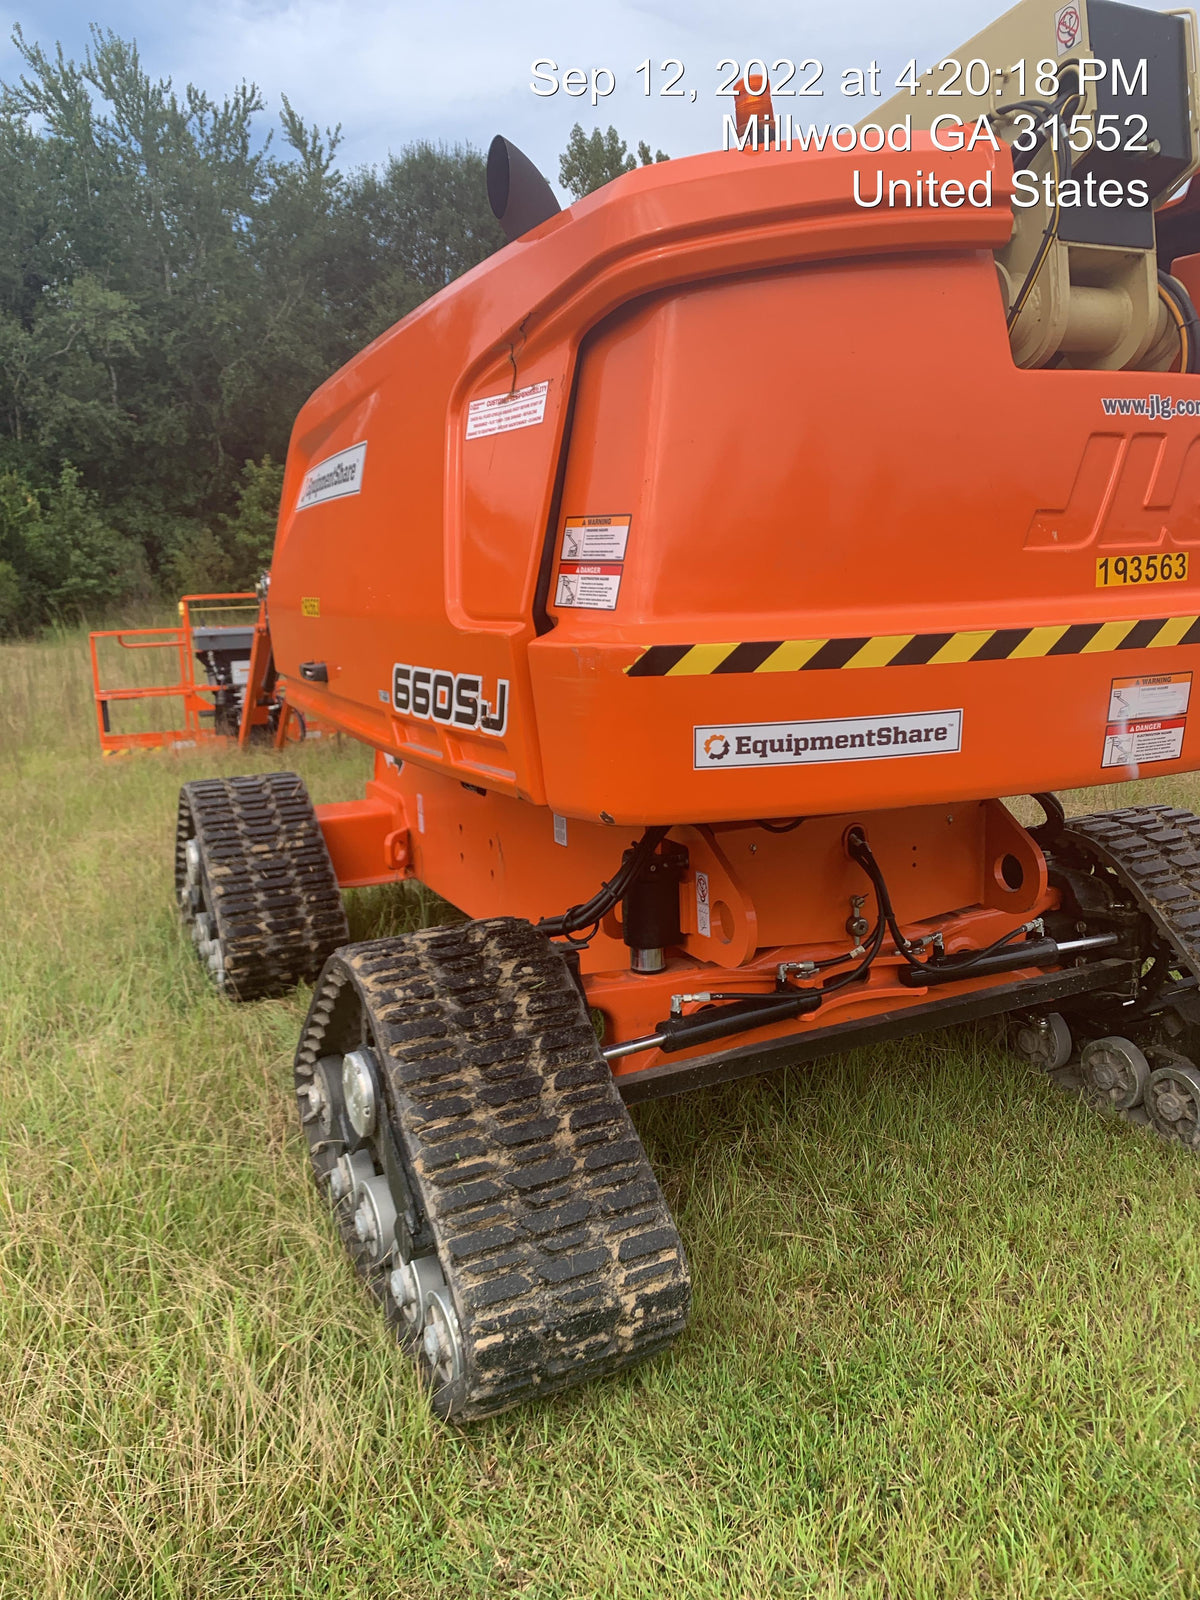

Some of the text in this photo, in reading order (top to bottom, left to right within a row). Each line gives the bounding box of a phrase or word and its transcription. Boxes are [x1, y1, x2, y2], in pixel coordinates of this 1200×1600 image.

[587, 518, 612, 526] WARNING
[580, 566, 601, 574] DANGER
[1099, 553, 1186, 585] 193563
[1142, 677, 1171, 685] WARNING
[394, 665, 508, 735] 660SJ
[1135, 723, 1161, 731] DANGER
[735, 725, 948, 757] EquipmentShare
